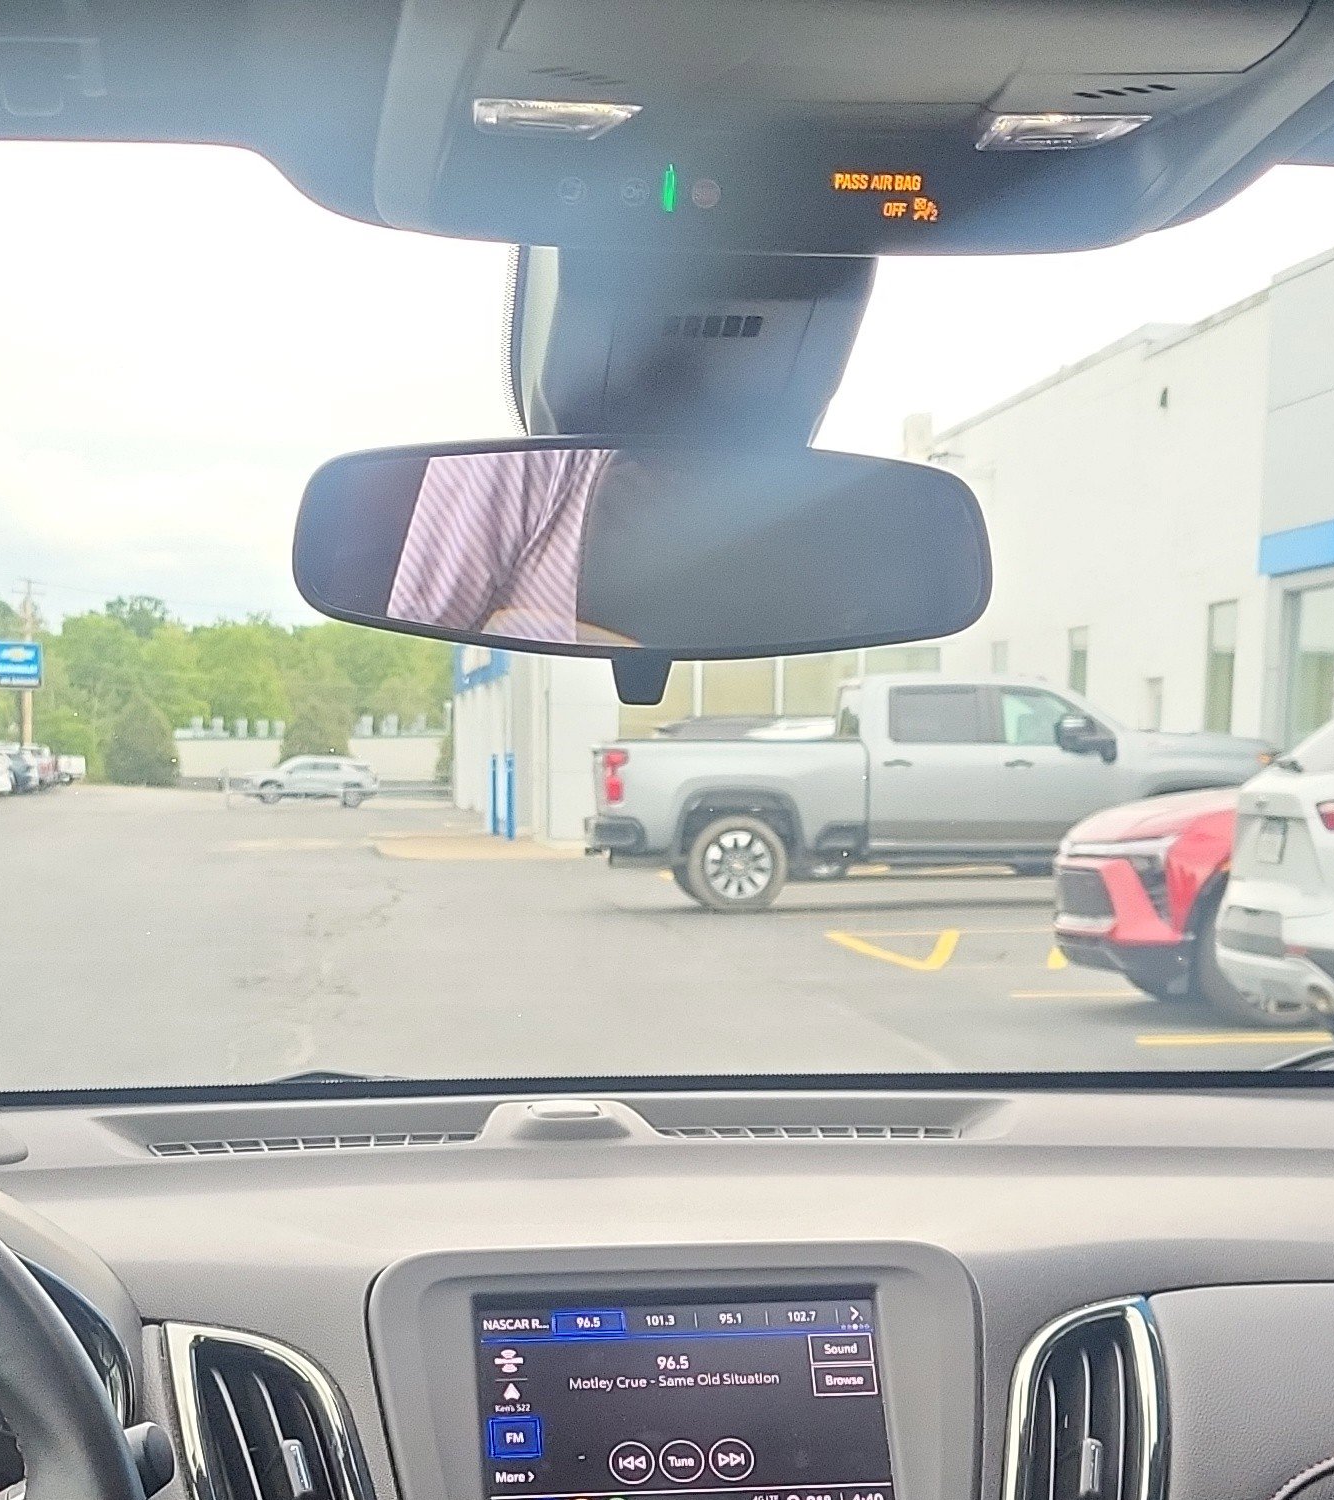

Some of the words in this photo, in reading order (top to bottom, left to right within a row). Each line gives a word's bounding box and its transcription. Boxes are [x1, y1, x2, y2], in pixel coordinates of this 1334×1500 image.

[834, 173, 869, 190] PASS
[870, 174, 893, 191] AIR
[895, 175, 921, 191] BAG
[883, 202, 908, 217] OFF
[645, 1315, 675, 1327] 101.3
[719, 1313, 742, 1325] 95.1
[787, 1311, 817, 1322] 102.7
[483, 1319, 530, 1331] NASCAR
[576, 1317, 601, 1329] 96.5
[824, 1342, 858, 1355] Sound
[657, 1356, 689, 1370] 96.5
[569, 1377, 614, 1392] Motley
[616, 1375, 648, 1389] Crue
[658, 1375, 695, 1387] Same
[697, 1374, 721, 1386] Old
[723, 1373, 780, 1386] Situation
[825, 1374, 865, 1386] Browse
[505, 1432, 525, 1444] FM
[667, 1455, 695, 1467] Tune
[495, 1471, 526, 1483] More
